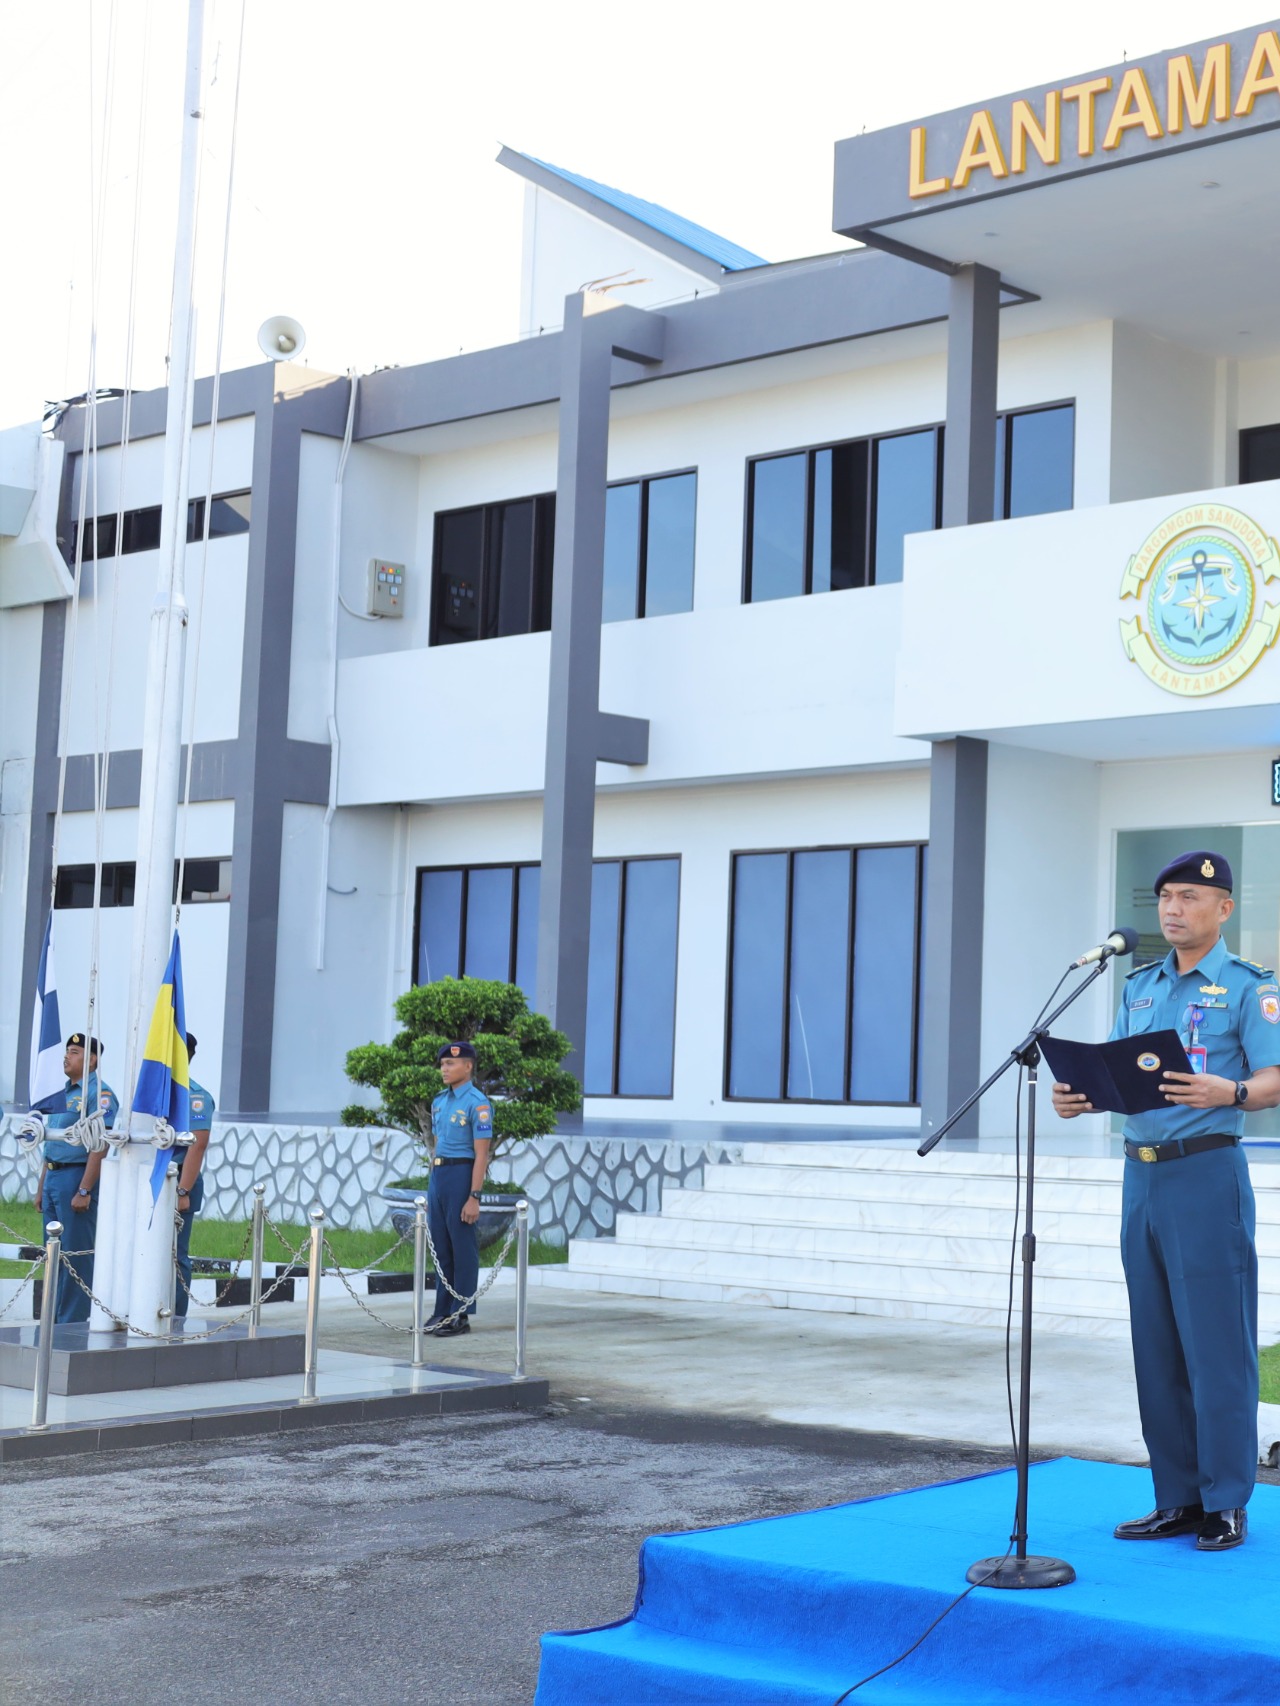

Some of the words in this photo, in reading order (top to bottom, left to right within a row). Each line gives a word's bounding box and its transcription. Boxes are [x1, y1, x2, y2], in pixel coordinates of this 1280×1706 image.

[1136, 509, 1204, 572] PARGOMGOM
[1207, 508, 1266, 560] SAMUDORA
[1151, 662, 1238, 692] LANTAMAL
